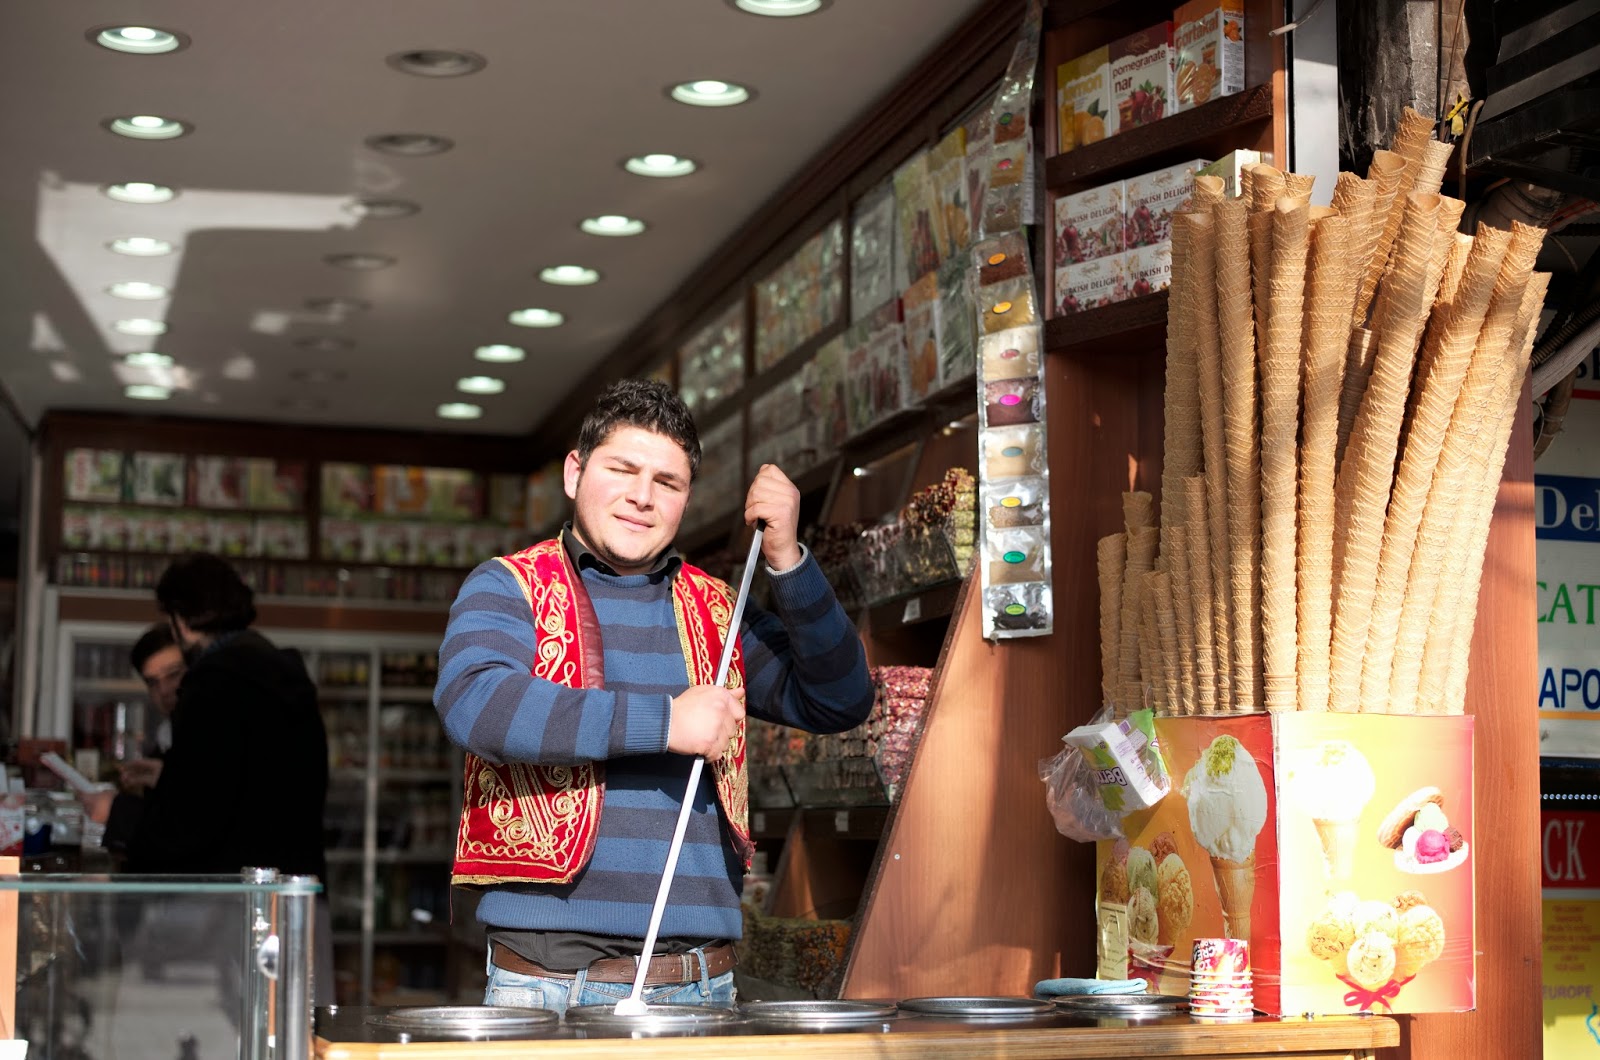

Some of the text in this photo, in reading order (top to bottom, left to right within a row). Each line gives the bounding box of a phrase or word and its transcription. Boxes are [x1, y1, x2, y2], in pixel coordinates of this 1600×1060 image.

[1175, 11, 1219, 55] portakal
[1112, 50, 1166, 79] pomegranate
[1114, 77, 1133, 93] nar
[1130, 184, 1197, 208] TURKISH DELIGHT
[1090, 203, 1118, 219] DELIGHT
[1130, 265, 1162, 280] TURKISH
[1091, 276, 1118, 290] DELIGHT
[1538, 667, 1600, 710] APO
[1543, 819, 1586, 881] CK
[1542, 984, 1594, 999] EUROPE
